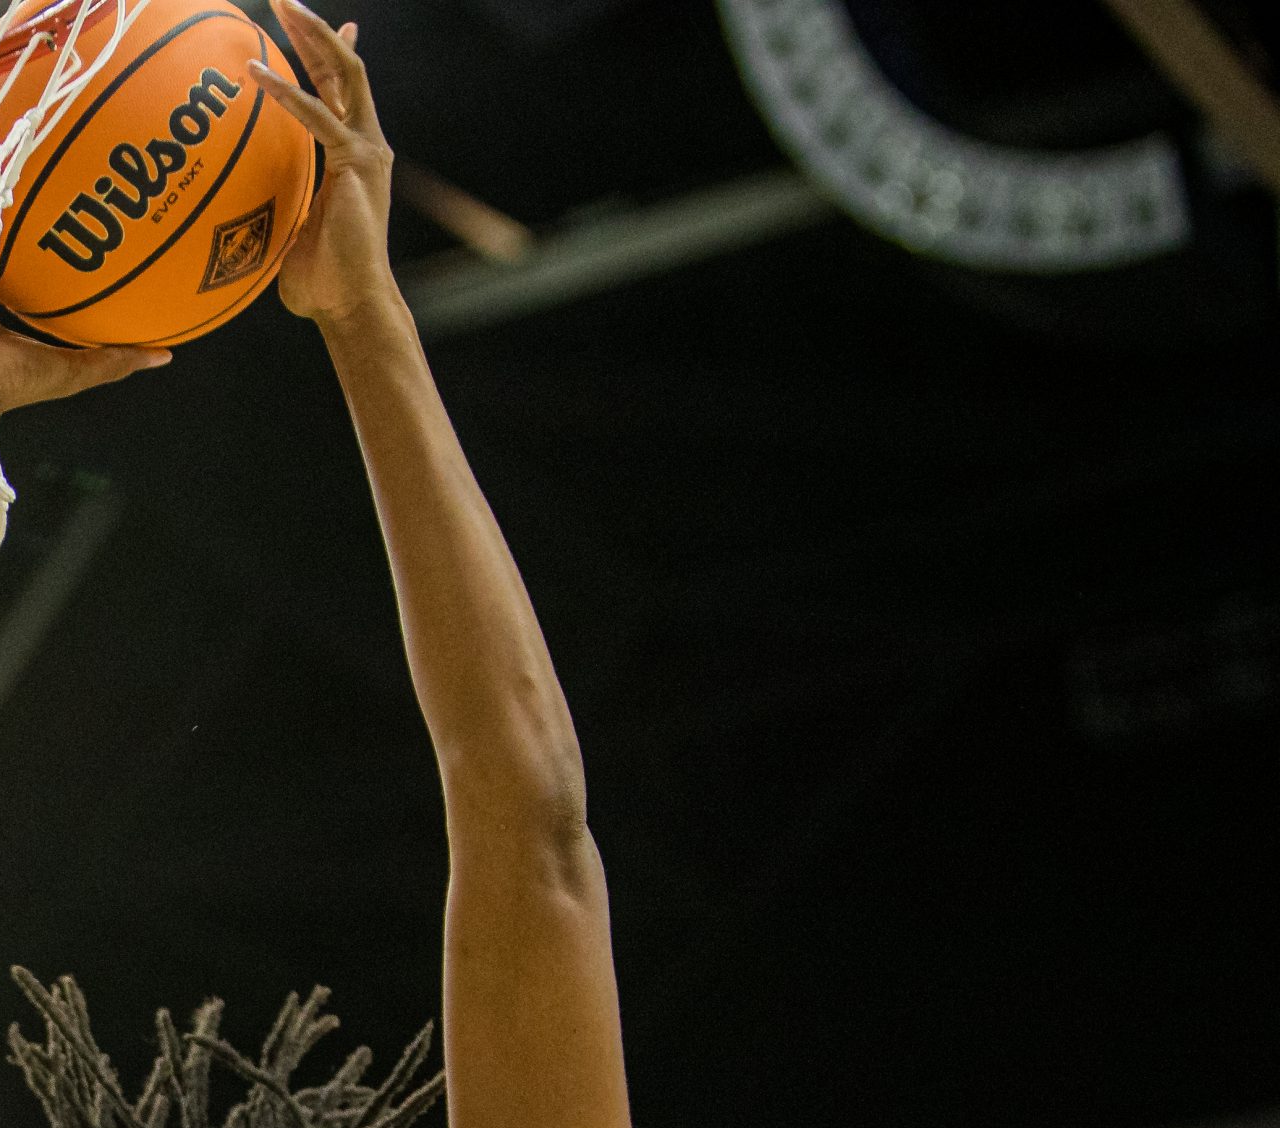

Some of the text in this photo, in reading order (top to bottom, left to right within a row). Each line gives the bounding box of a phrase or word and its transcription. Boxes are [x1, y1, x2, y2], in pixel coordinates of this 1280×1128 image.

[37, 67, 241, 272] Wilson
[152, 157, 205, 224] EVO NXT
